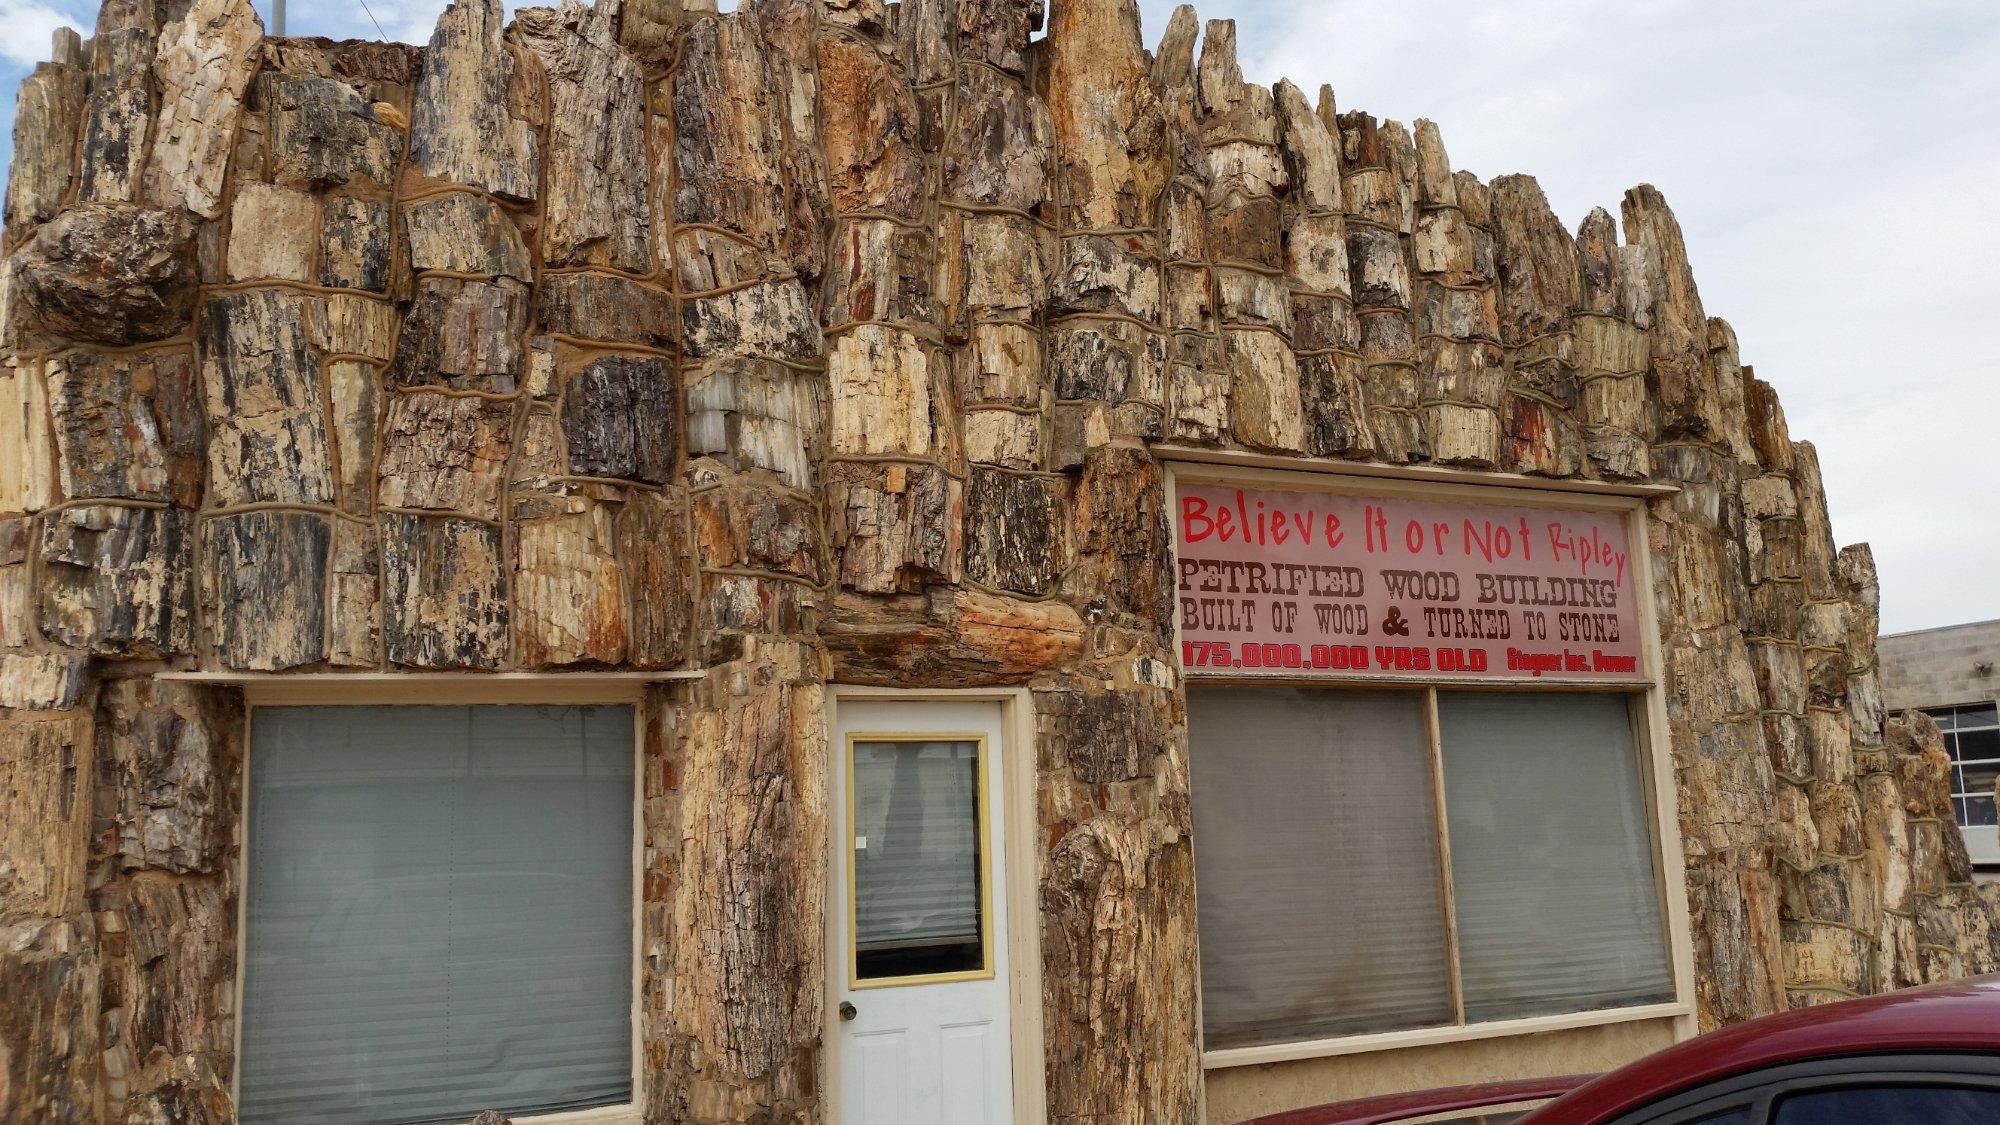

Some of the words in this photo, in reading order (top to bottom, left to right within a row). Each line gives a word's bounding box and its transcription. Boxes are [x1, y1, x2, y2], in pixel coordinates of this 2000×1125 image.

[1182, 490, 1344, 548] Believe
[1366, 506, 1388, 553] It
[1405, 520, 1449, 555] or
[1464, 517, 1530, 563] Not
[1548, 522, 1625, 587] Ripley
[1178, 558, 1364, 598] PETRIFIED
[1380, 569, 1460, 601] WOOD
[1476, 574, 1617, 607] BUILDING
[1181, 598, 1256, 632] BUILT
[1272, 602, 1298, 633] OF
[1313, 604, 1368, 636] WOOD
[1382, 607, 1409, 637] &
[1424, 608, 1511, 640] TURNED
[1523, 611, 1546, 641] TO
[1559, 613, 1620, 643] STONE
[1182, 641, 1369, 669] 175,000,000
[1375, 647, 1431, 670] YRS
[1437, 648, 1487, 672] OLD
[1564, 648, 1591, 672] Inc.
[1593, 650, 1636, 674] Owner
